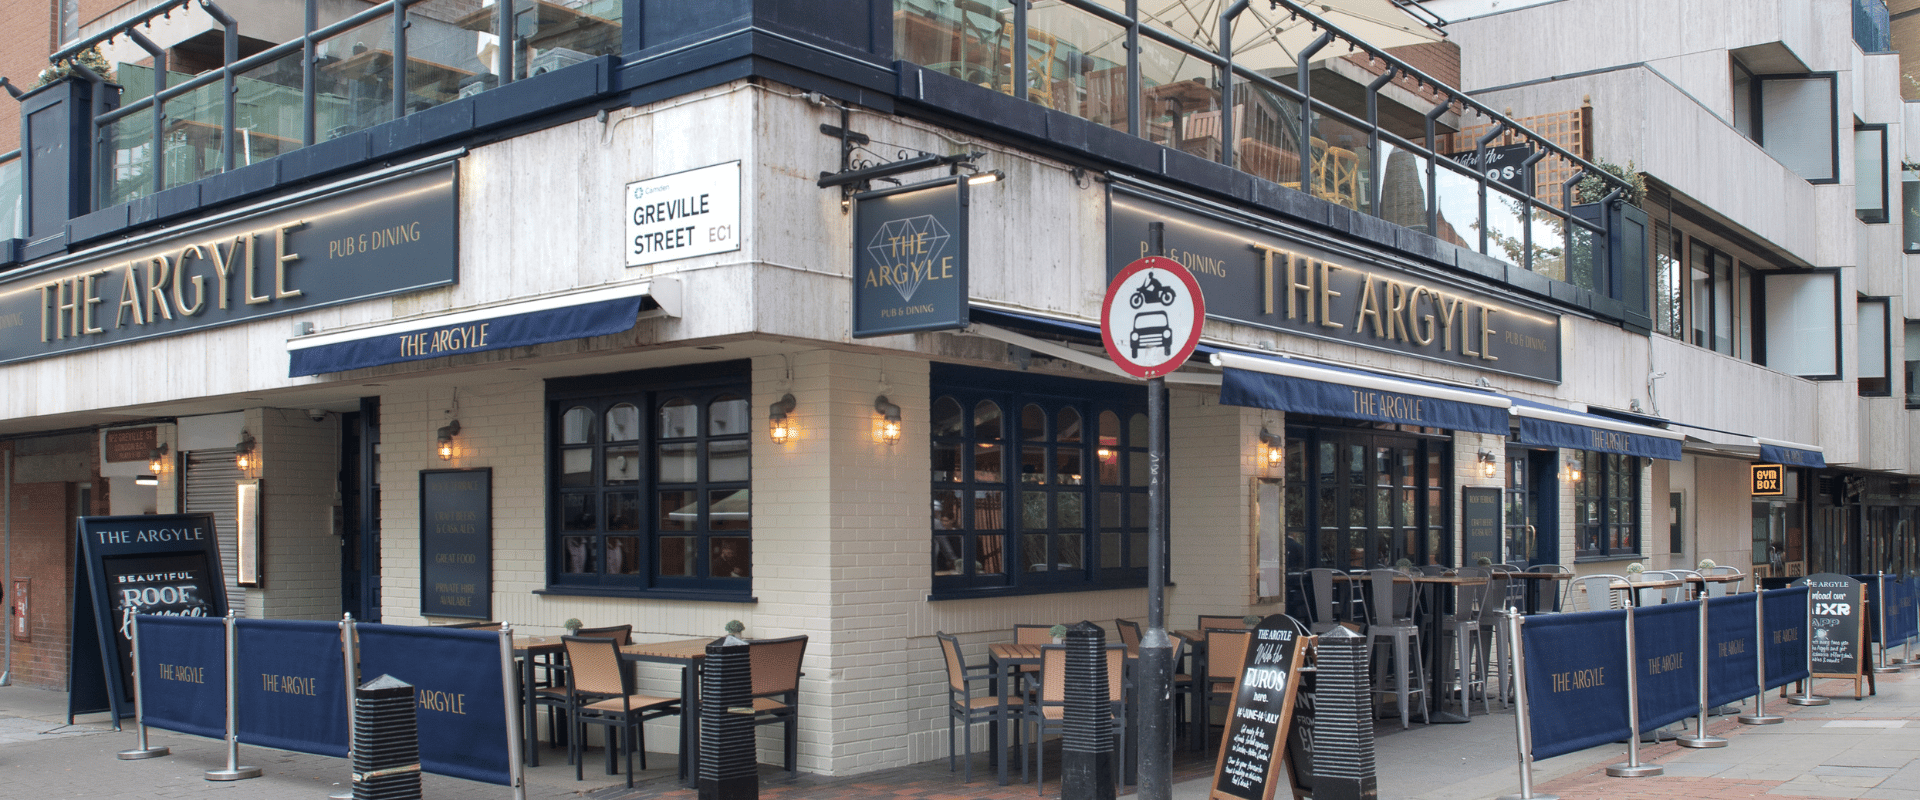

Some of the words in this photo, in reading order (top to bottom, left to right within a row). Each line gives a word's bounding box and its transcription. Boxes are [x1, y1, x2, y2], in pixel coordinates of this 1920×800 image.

[645, 184, 670, 195] Camden
[633, 193, 710, 226] GREVILLE
[329, 234, 355, 259] PUB
[358, 234, 368, 253] &
[371, 221, 421, 251] DINING
[633, 226, 695, 255] STREET
[708, 224, 732, 243] EC1
[888, 232, 928, 258] THE
[864, 256, 953, 289] ARGYLE
[1183, 251, 1226, 278] DINING
[36, 270, 107, 343] THE
[115, 220, 303, 330] ARGYLE
[881, 308, 896, 318] PUB
[898, 307, 903, 316] &
[905, 304, 934, 316] DINING
[1253, 241, 1344, 329] THE
[1356, 272, 1498, 362] ARGYLE
[400, 332, 428, 357] THE
[430, 323, 489, 353] ARGYLE
[1505, 330, 1519, 346] PUB
[1525, 335, 1547, 352] DINING
[1352, 390, 1378, 416] THE
[1380, 394, 1423, 421] ARGYLE
[1591, 429, 1605, 449] THE
[1605, 431, 1630, 452] ARGYLE
[1756, 470, 1777, 480] GYM
[1756, 480, 1777, 490] BOX
[96, 530, 132, 544] THE
[136, 528, 204, 543] ARGYLE
[435, 553, 456, 563] GREAT
[456, 553, 476, 564] FOOD
[118, 571, 193, 583] BEAUTIFUL
[122, 585, 197, 607] ROOF
[435, 583, 460, 593] PRIVATE
[460, 583, 476, 594] HIRE
[1811, 590, 1832, 600] nload
[440, 595, 472, 607] AVAILABLE
[1811, 603, 1851, 616] iXR
[1257, 629, 1270, 640] THE
[1269, 630, 1293, 642] ARGYLE
[159, 663, 174, 681] THE
[175, 665, 205, 684] ARGYLE
[1648, 656, 1662, 675] THE
[1661, 652, 1684, 672] ARGYLE
[262, 673, 279, 693] THE
[281, 675, 316, 696] ARGYLE
[1244, 667, 1287, 692] EUROS
[1551, 671, 1571, 693] THE
[1572, 666, 1605, 690] ARGYLE
[418, 689, 467, 715] ARGYLE
[1265, 713, 1280, 724] JULY
